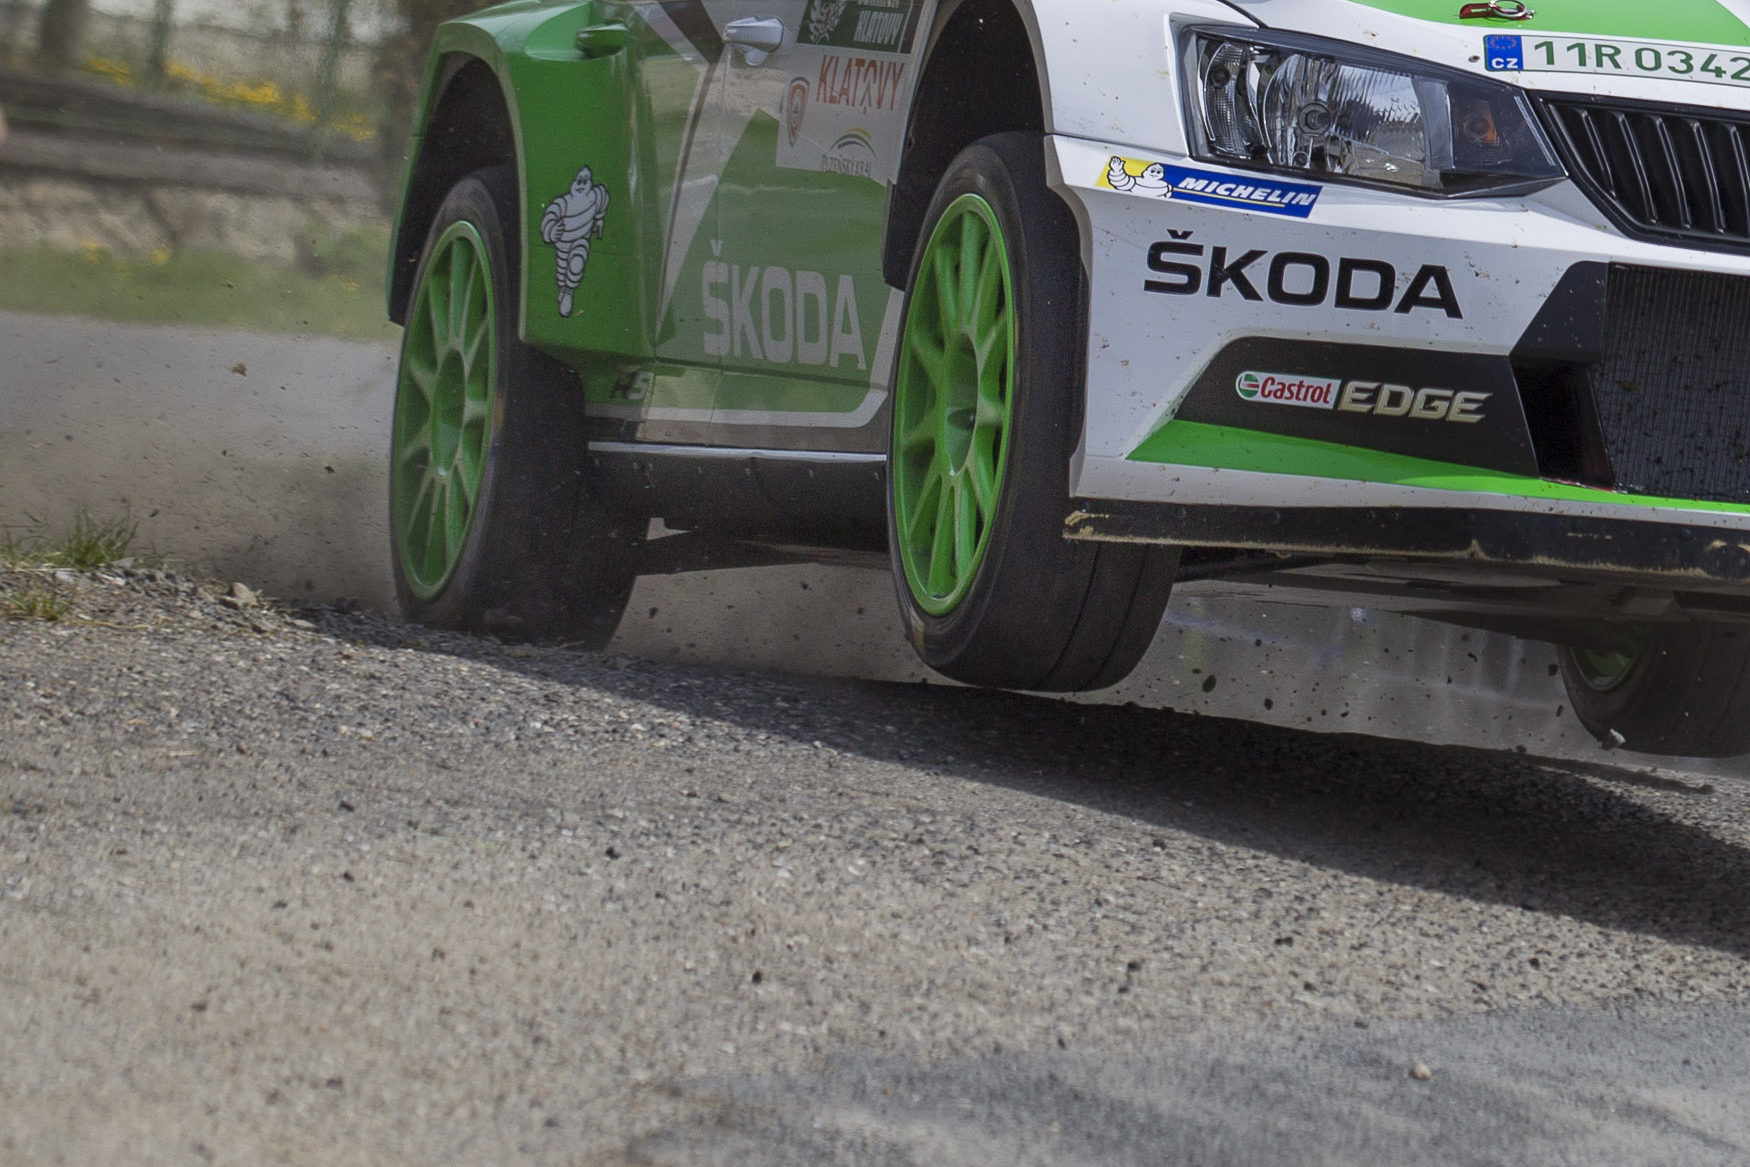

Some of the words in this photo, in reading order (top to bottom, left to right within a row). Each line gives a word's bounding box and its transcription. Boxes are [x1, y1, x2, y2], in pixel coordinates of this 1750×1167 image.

[816, 54, 905, 112] KLATOVY
[1491, 57, 1519, 69] CZ
[1177, 176, 1317, 208] MICHELIN
[1143, 228, 1464, 320] ŠKODA
[701, 239, 868, 371] ŠKODA
[1259, 375, 1334, 406] Castrol
[1338, 380, 1493, 424] EDGE
